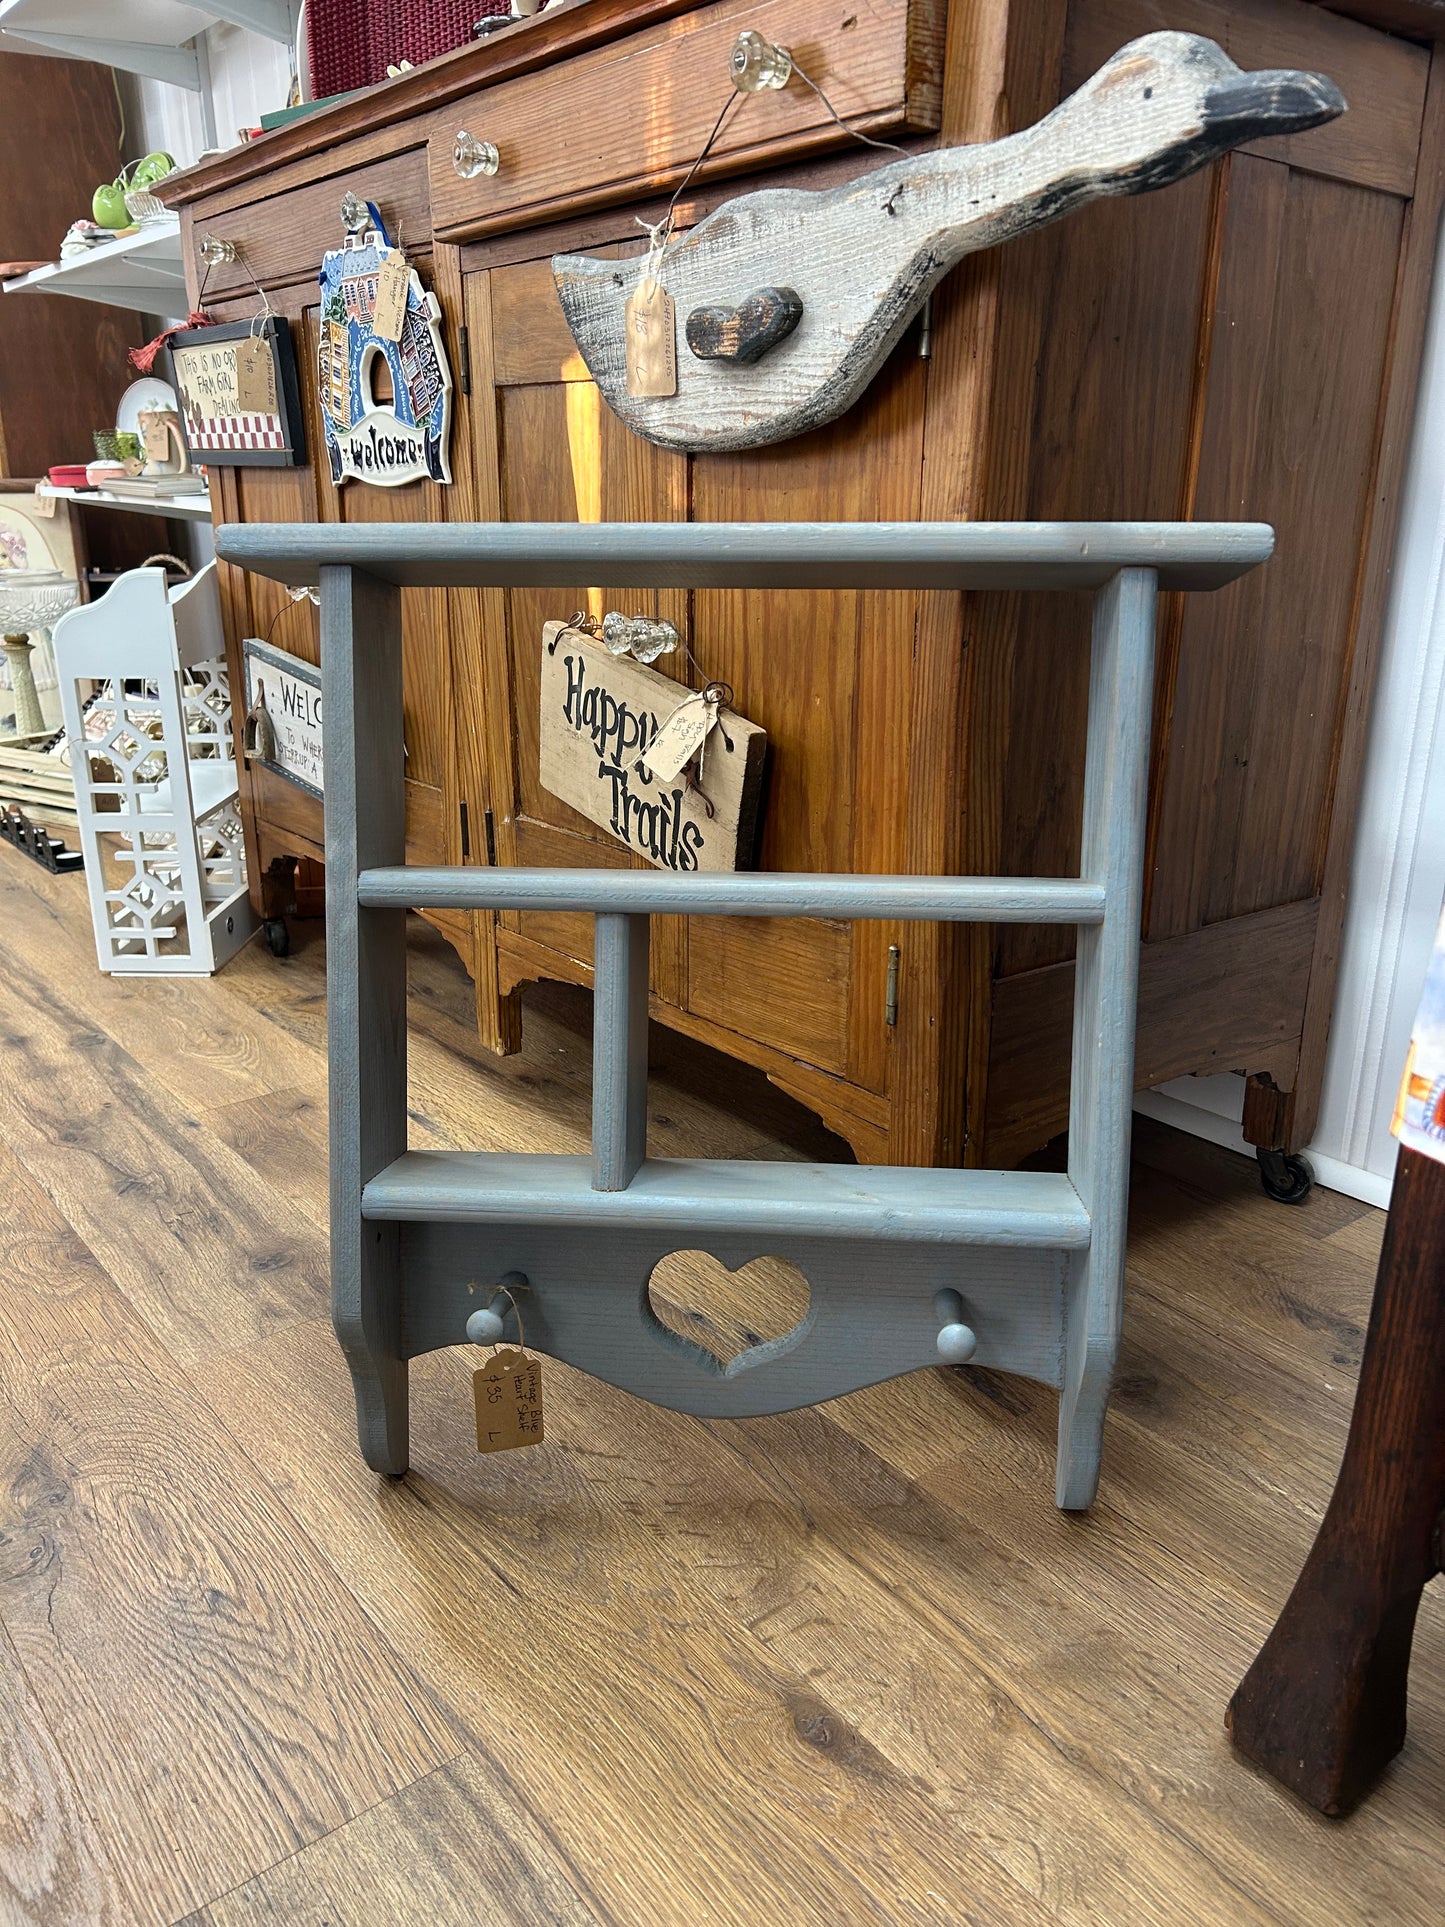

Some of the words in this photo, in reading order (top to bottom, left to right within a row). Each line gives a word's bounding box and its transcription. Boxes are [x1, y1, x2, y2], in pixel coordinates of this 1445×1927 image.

[211, 353, 222, 370] NO
[197, 375, 217, 396] FARM
[280, 676, 323, 729] WELC
[598, 760, 705, 871] Trails
[513, 1374, 527, 1401] Heart
[526, 1363, 538, 1404] Vintage
[517, 1404, 530, 1433] Shelf
[530, 1409, 543, 1433] Blue
[488, 1431, 502, 1443] L
